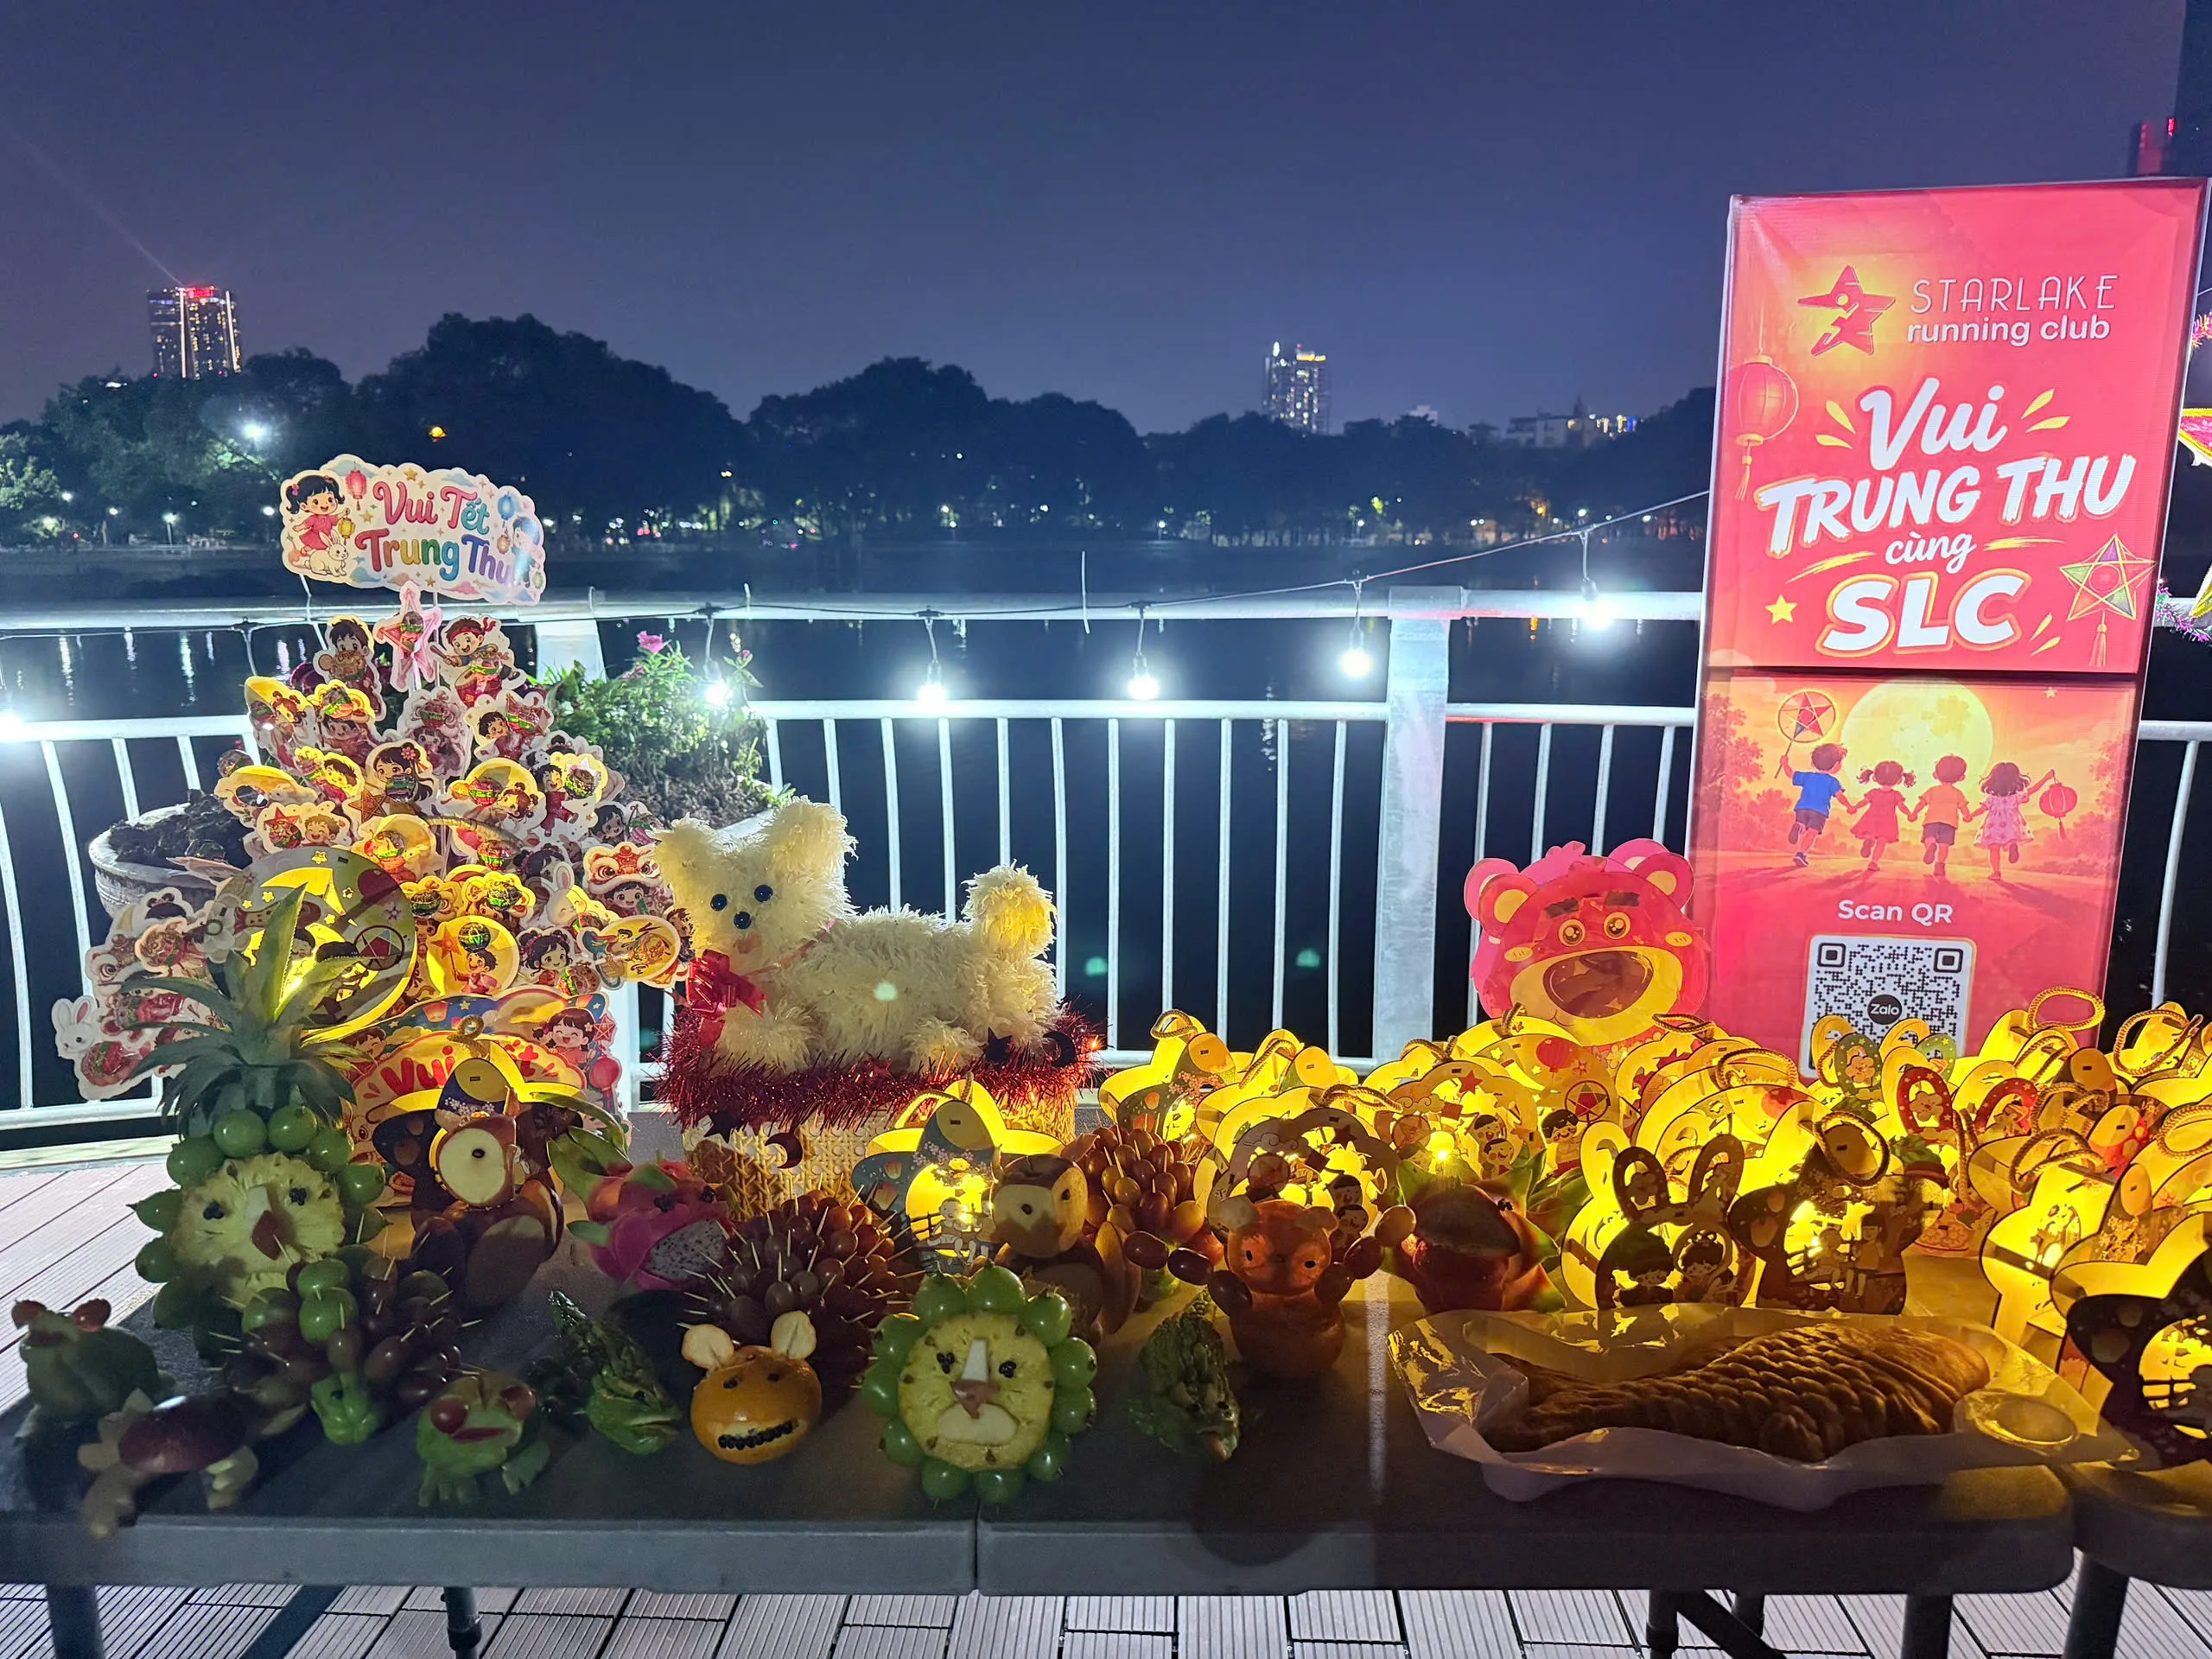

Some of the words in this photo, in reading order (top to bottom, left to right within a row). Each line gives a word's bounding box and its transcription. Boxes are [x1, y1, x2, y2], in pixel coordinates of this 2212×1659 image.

[1910, 274, 2119, 314] STARLAKE
[1906, 317, 2030, 346] running
[2039, 315, 2111, 340] club
[1859, 377, 2009, 472] Vui
[372, 481, 439, 525] Vui
[441, 486, 490, 536] Tết
[1757, 469, 1981, 556] TRUNG
[1996, 453, 2138, 523] THU
[354, 528, 460, 582] Trung
[461, 534, 513, 585] Thu
[1884, 531, 1977, 574] cùng
[1820, 572, 2028, 654] SLC
[1838, 899, 1903, 921] Scan
[1911, 903, 1954, 926] QR
[1870, 1003, 1900, 1015] Zalo
